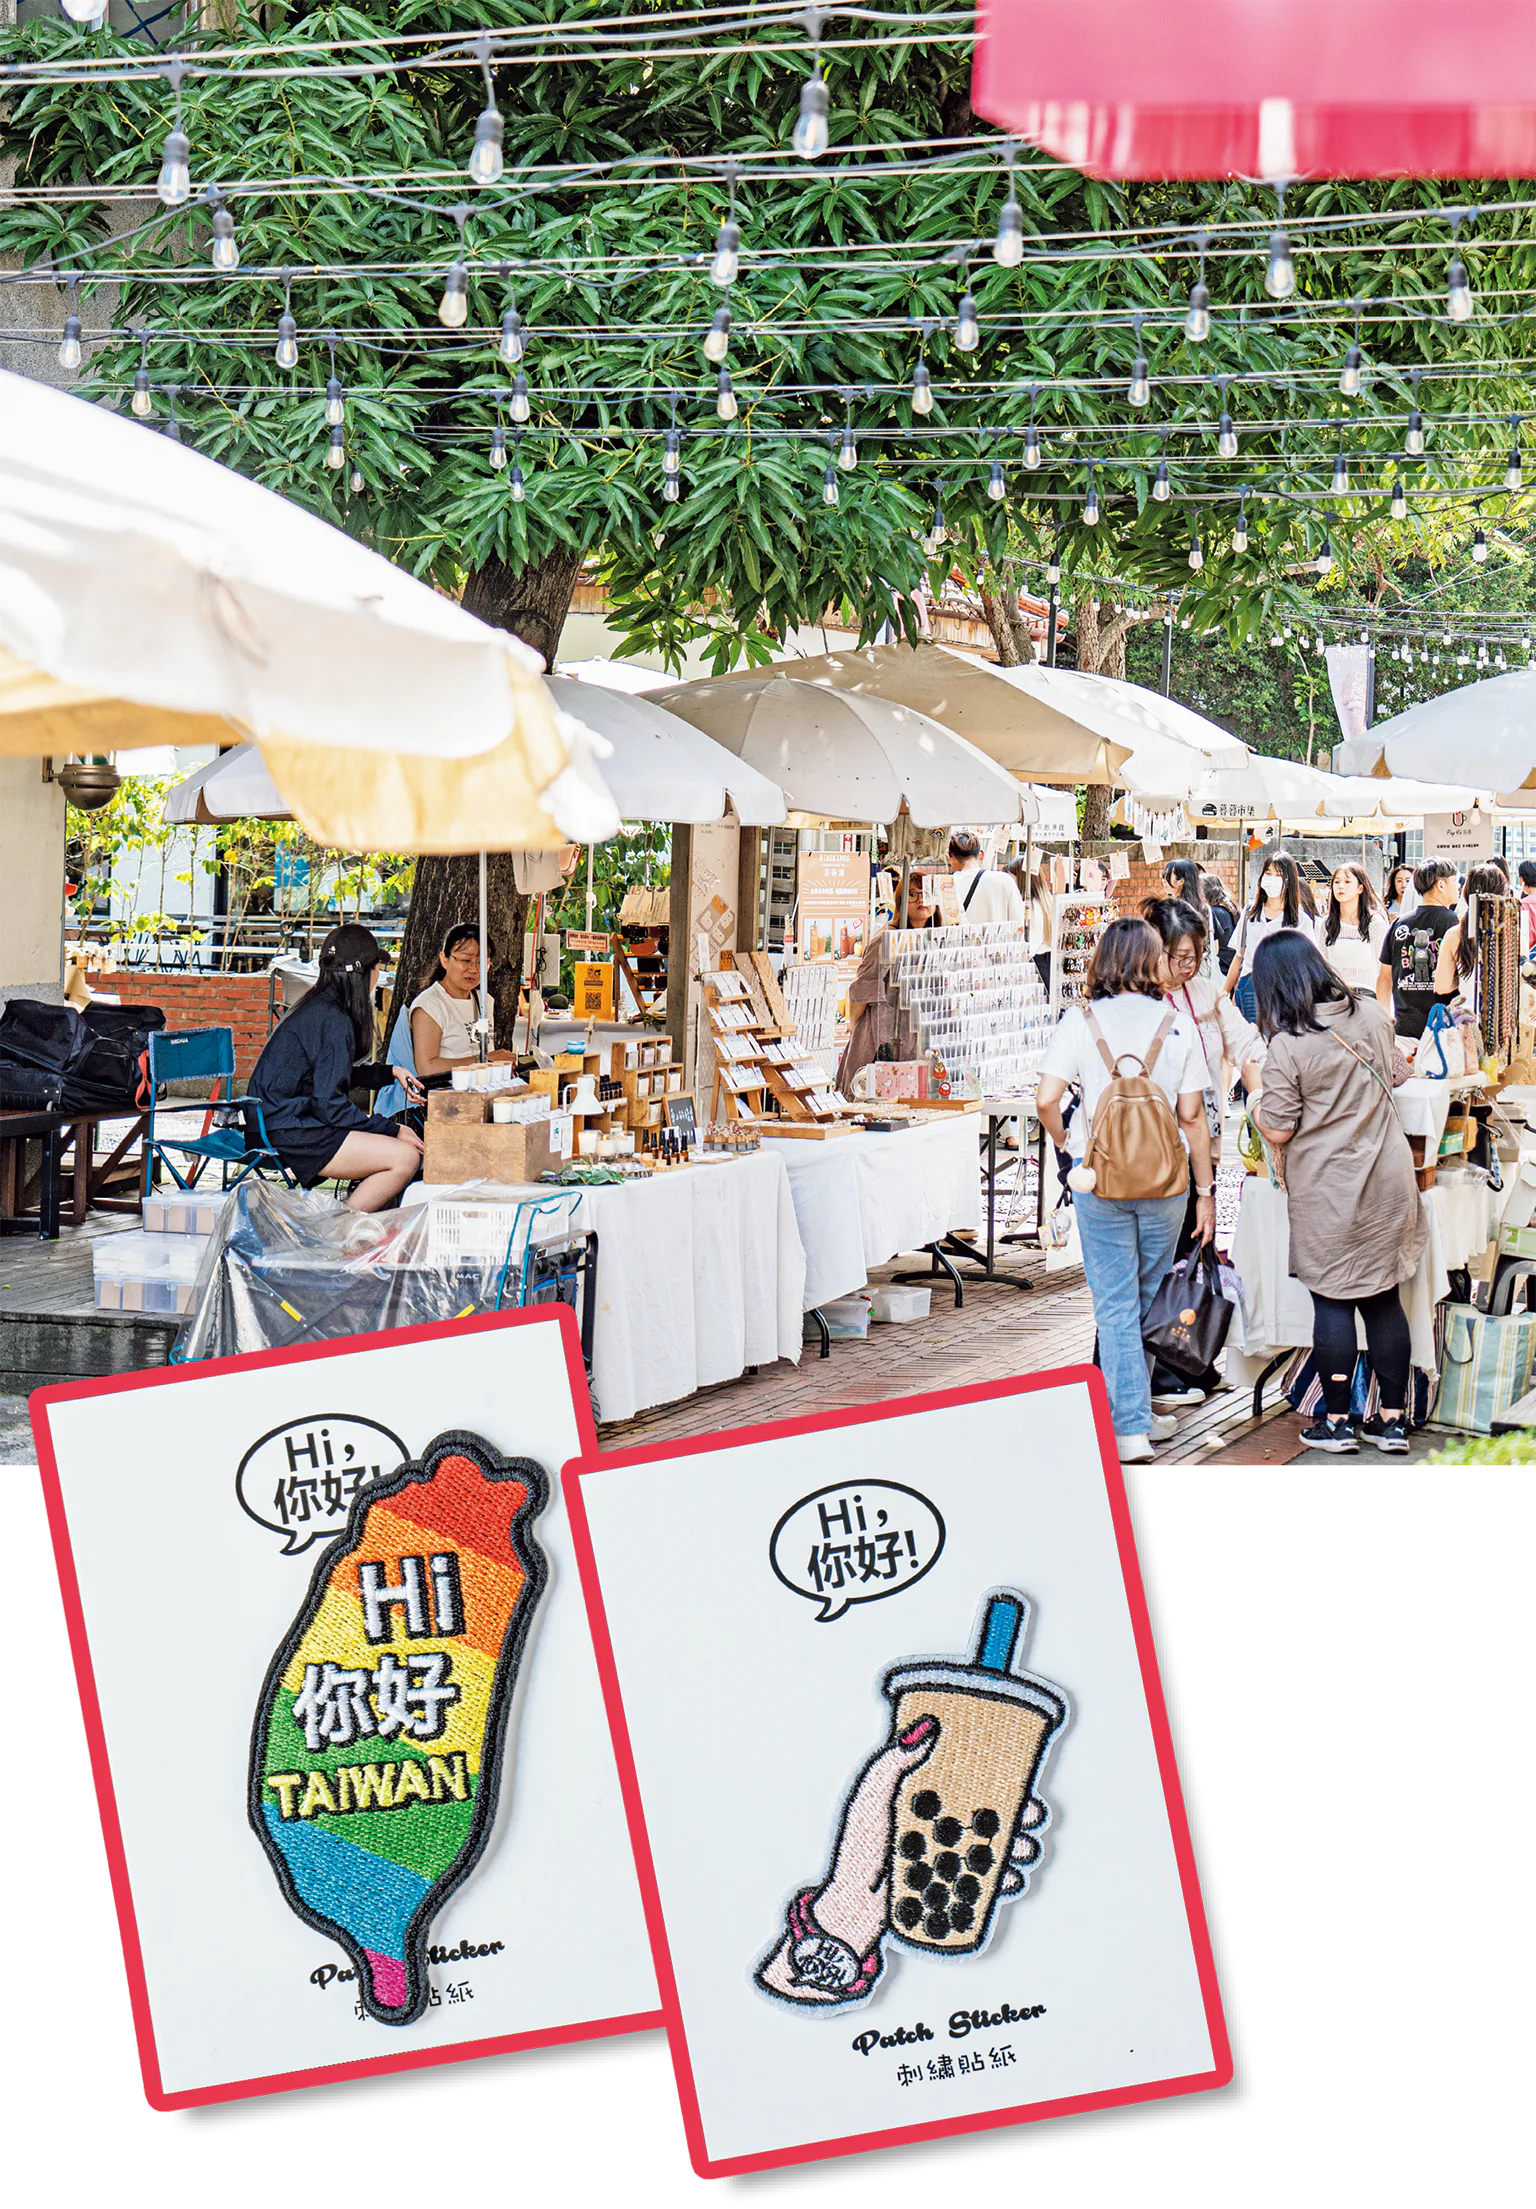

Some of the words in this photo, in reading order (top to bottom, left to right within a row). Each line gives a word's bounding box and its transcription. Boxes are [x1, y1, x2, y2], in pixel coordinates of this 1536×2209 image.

[817, 1494, 888, 1539] Hi,
[807, 1529, 919, 1592] 你好!
[359, 1552, 465, 1645] Hi
[292, 1652, 459, 1751] 你好
[267, 1750, 473, 1823] TAIWAN
[425, 1939, 506, 1966] ticker
[852, 2021, 934, 2056] Patch
[948, 2003, 1047, 2038] Sticker
[896, 2044, 1017, 2087] 刺繡貼紙
